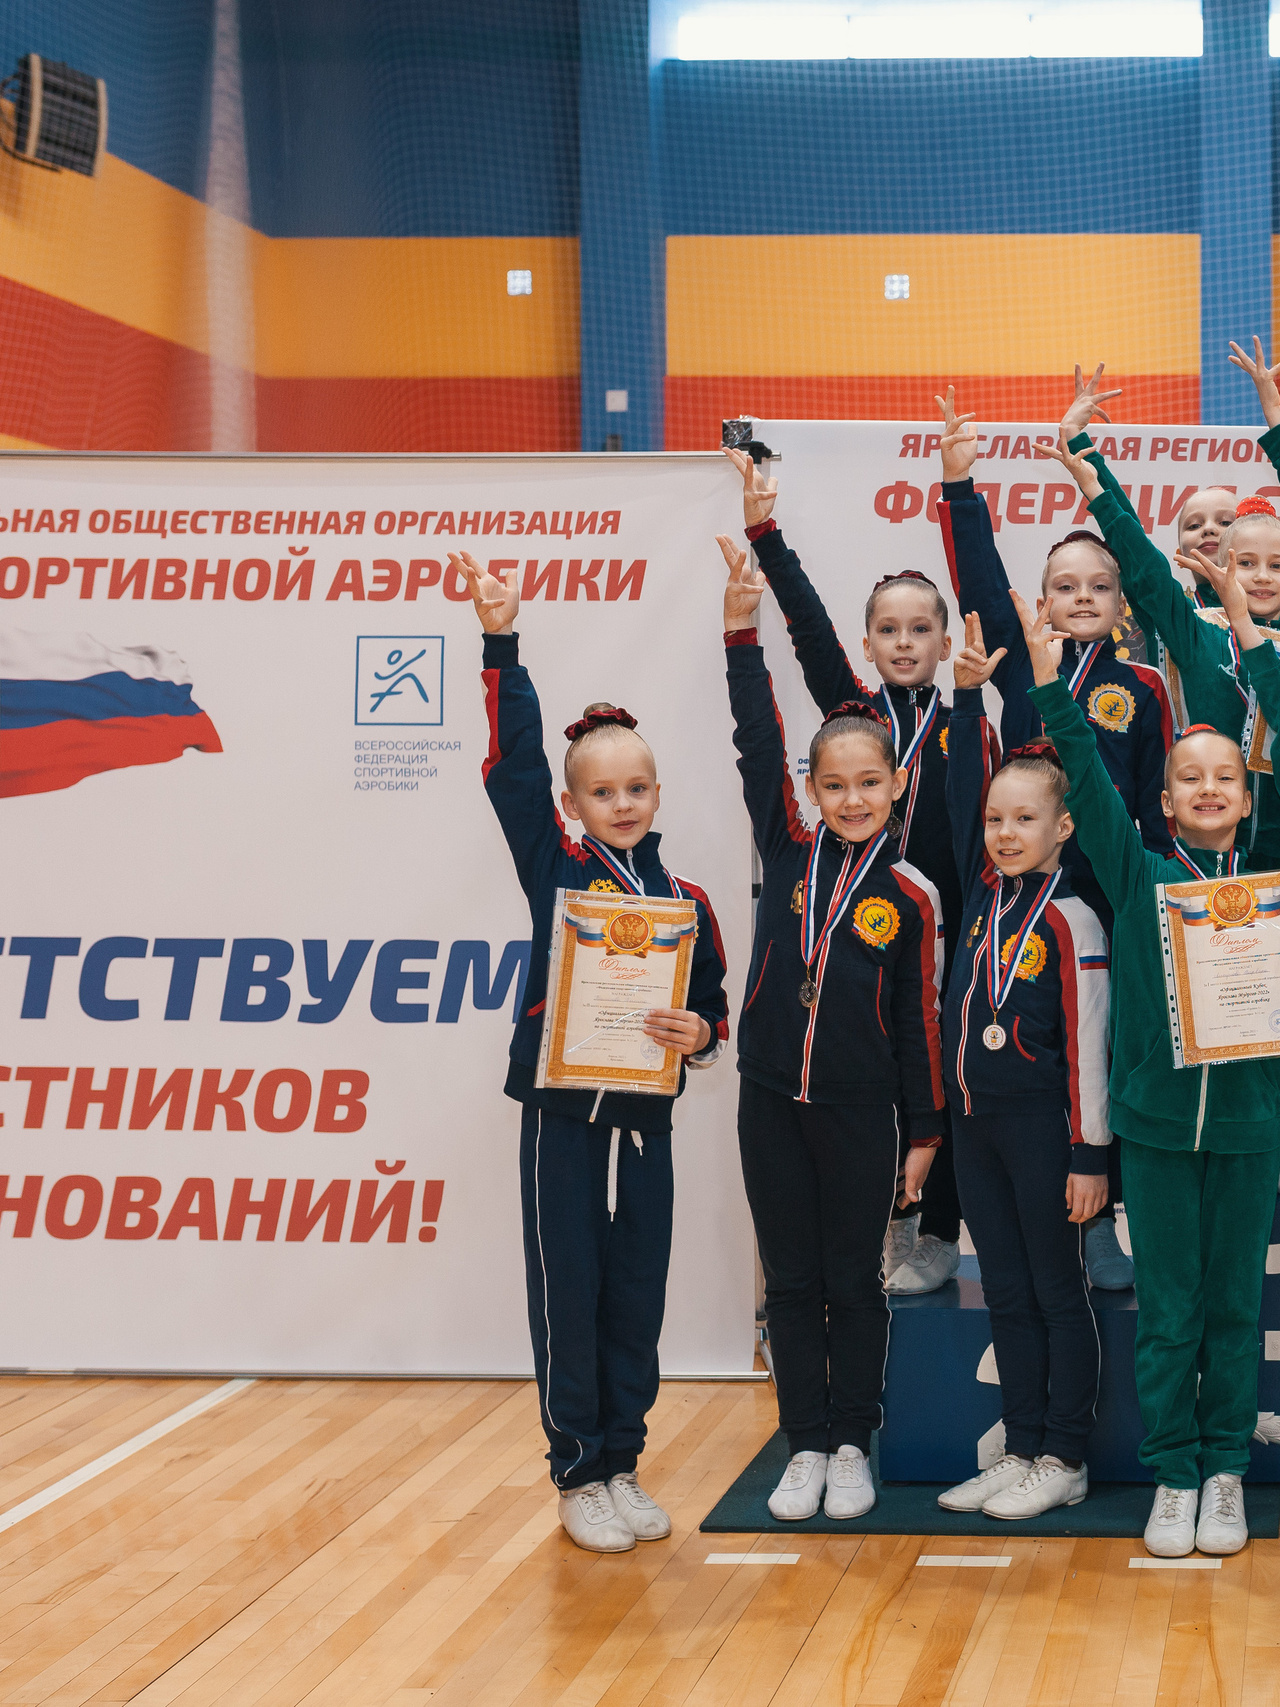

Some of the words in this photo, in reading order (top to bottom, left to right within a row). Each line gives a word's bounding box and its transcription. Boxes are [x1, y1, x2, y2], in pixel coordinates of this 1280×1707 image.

[899, 433, 1141, 461] ЯРСЛАВАЯ
[88, 509, 366, 539] ОБЩЕСТВЕННАЯ
[374, 510, 621, 540] ОРГАНИЗАЦИЯ
[354, 739, 461, 751] ВСЕРОССИЙСКАЯ
[354, 754, 428, 765] ФЕДЕРАЦИЯ
[354, 766, 438, 778] СПОРТИВНОЙ
[354, 781, 419, 791] АЭРОБИКИ
[0, 936, 532, 1024] ТСТВУЕМ
[0, 1065, 369, 1133] ТНИКОВ
